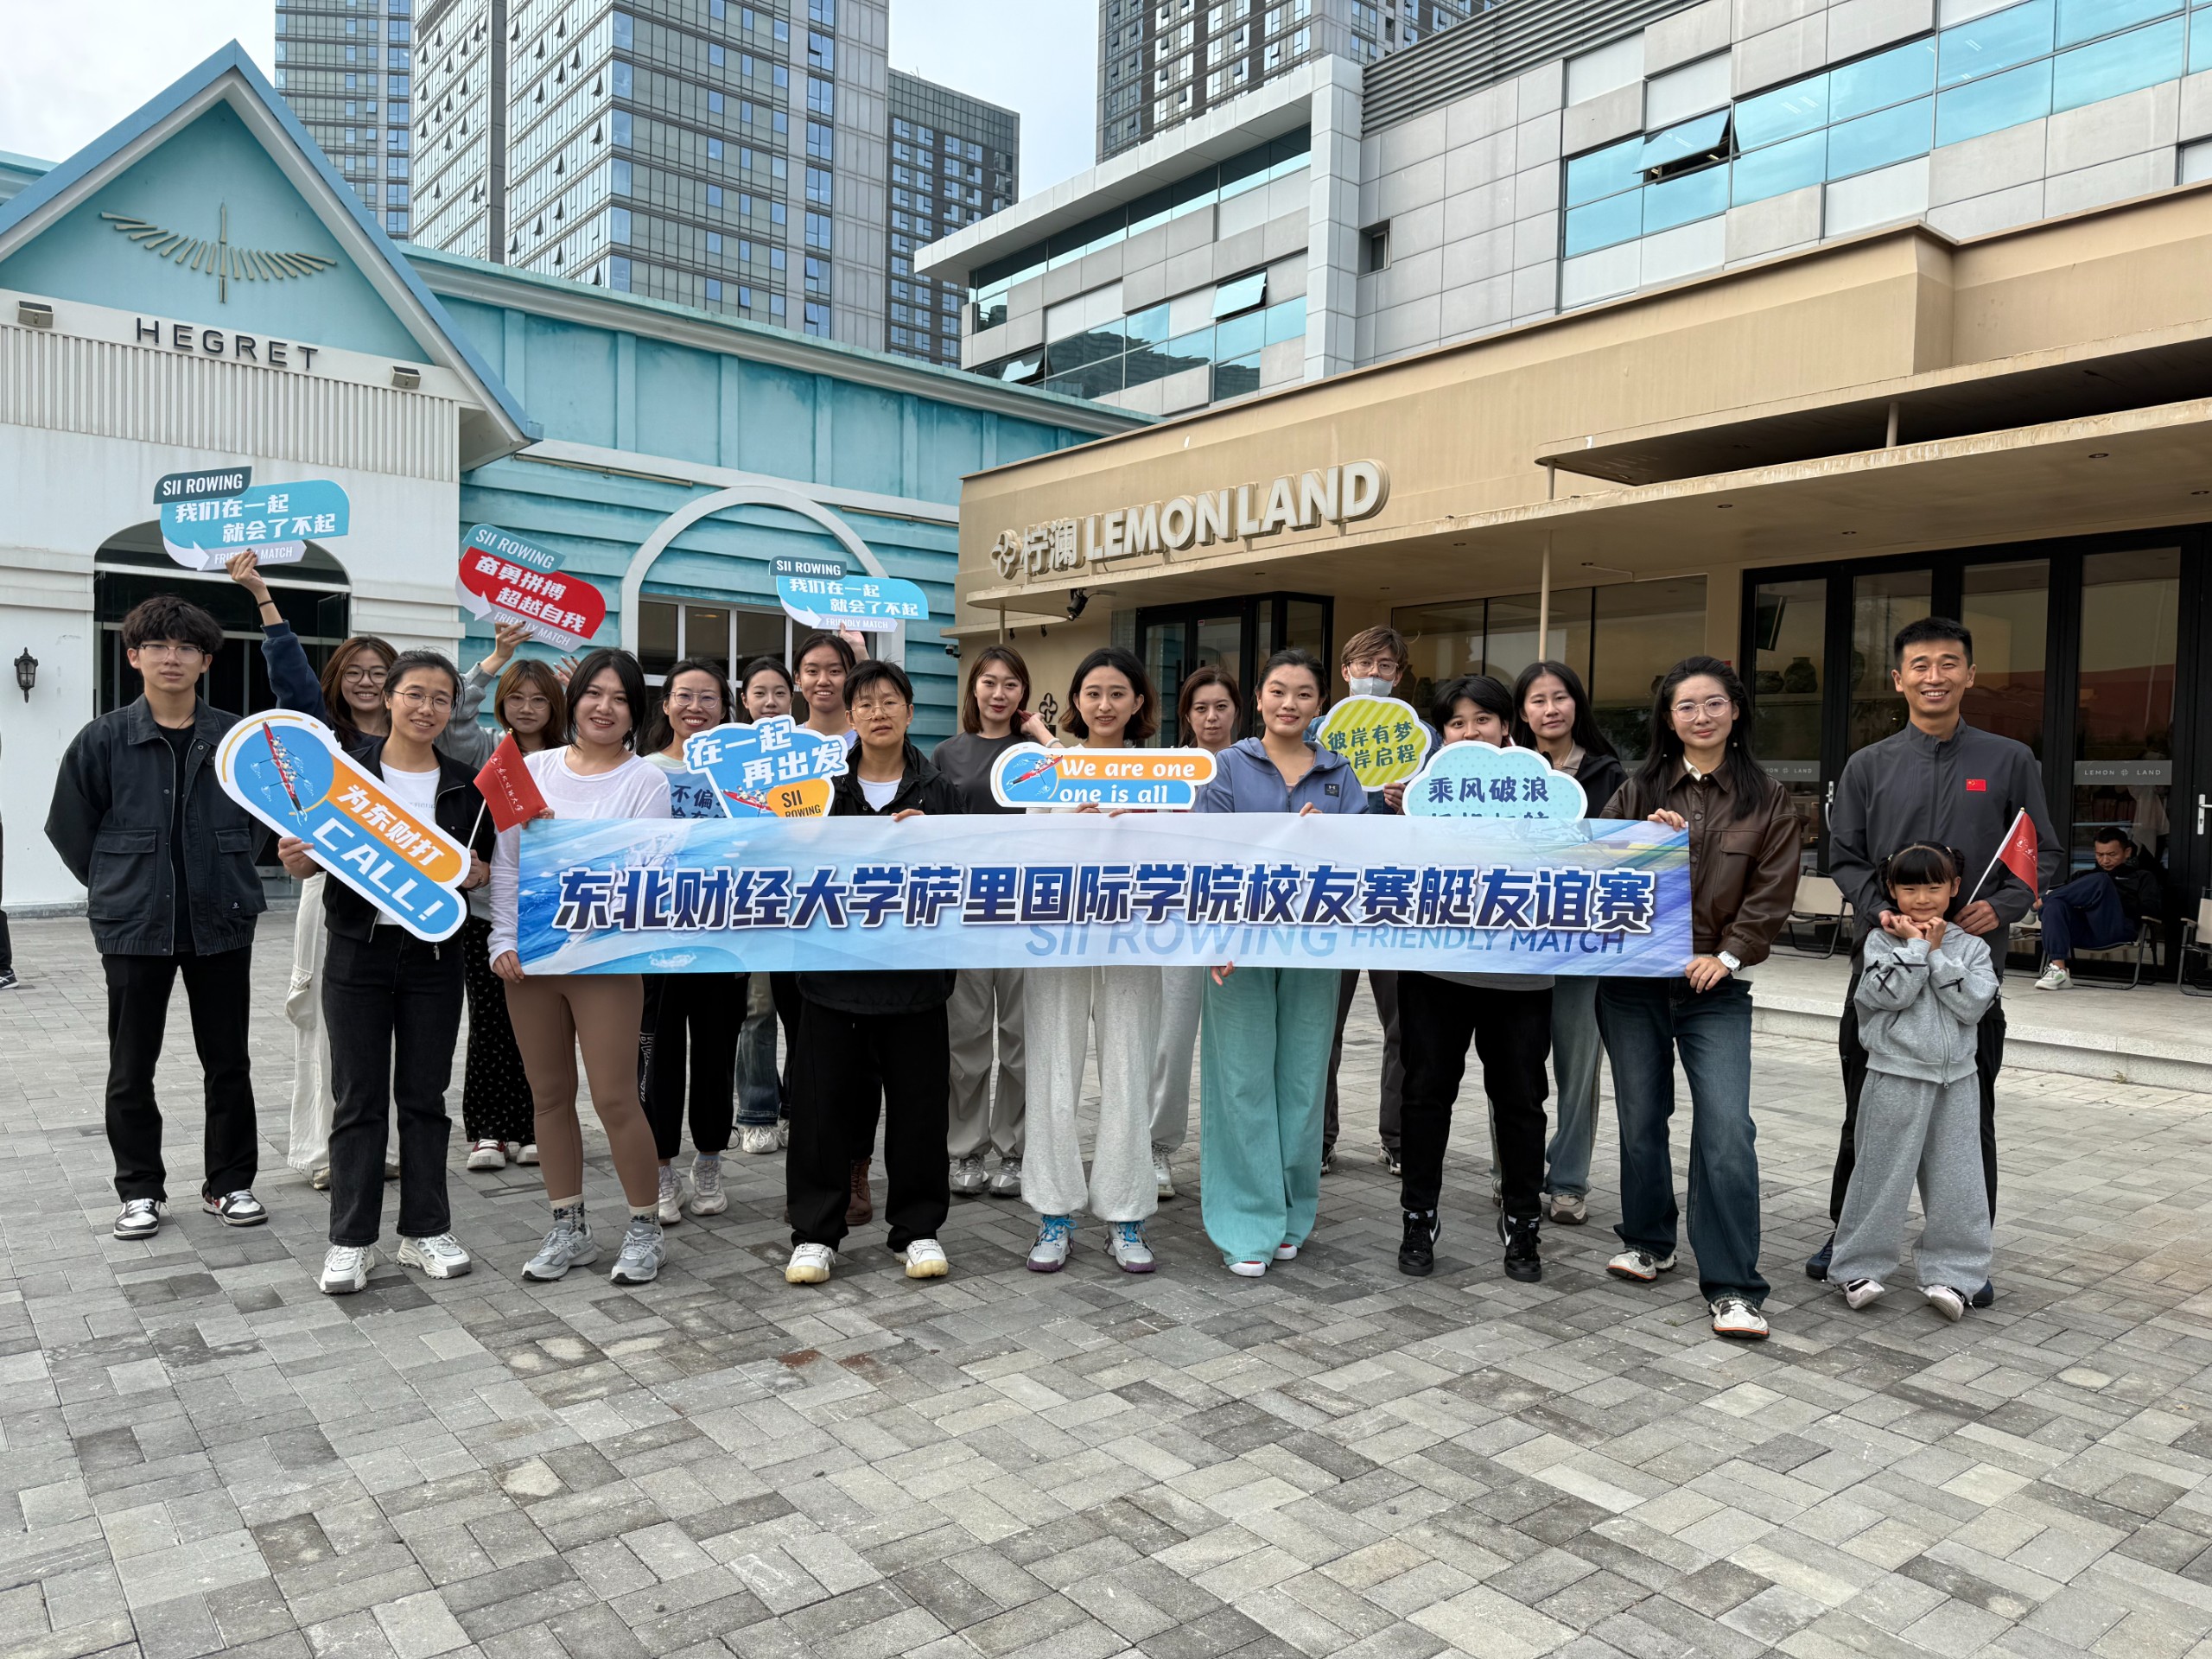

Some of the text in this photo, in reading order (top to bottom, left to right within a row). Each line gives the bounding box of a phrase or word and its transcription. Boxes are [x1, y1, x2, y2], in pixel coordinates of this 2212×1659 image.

[137, 317, 319, 371] HEGRET
[162, 474, 243, 496] SII ROWING
[175, 493, 289, 523] 我们在一起
[222, 513, 335, 543] 就会了不起
[261, 546, 292, 560] MATCH
[475, 529, 555, 569] SII ROWING
[1020, 519, 1080, 574] 柠澜
[474, 556, 567, 601] 奋勇拼搏
[776, 560, 841, 575] SII ROWING
[789, 578, 880, 597] 我们在一起
[495, 587, 587, 632] 超越自我
[830, 598, 918, 616] 就会了不起
[537, 627, 570, 646] MATCH
[863, 620, 888, 629] MATCH
[690, 721, 791, 767] 在一起
[1327, 721, 1414, 750] 彼岸有梦
[742, 742, 842, 789] 再出发
[1061, 759, 1195, 777] We are one
[1339, 744, 1417, 769] 岸启程
[671, 785, 721, 810] 不偏
[781, 790, 803, 808] SII
[1059, 785, 1167, 803] one is all
[1428, 775, 1549, 804] 乘风破浪
[336, 784, 445, 866] 为东财打
[313, 817, 445, 922] CALL!
[553, 861, 1654, 933] 东北财经大学萨里国际学院校友赛艇友谊赛
[1025, 910, 1624, 957] SII ROWING FRIENDLY MATCH
